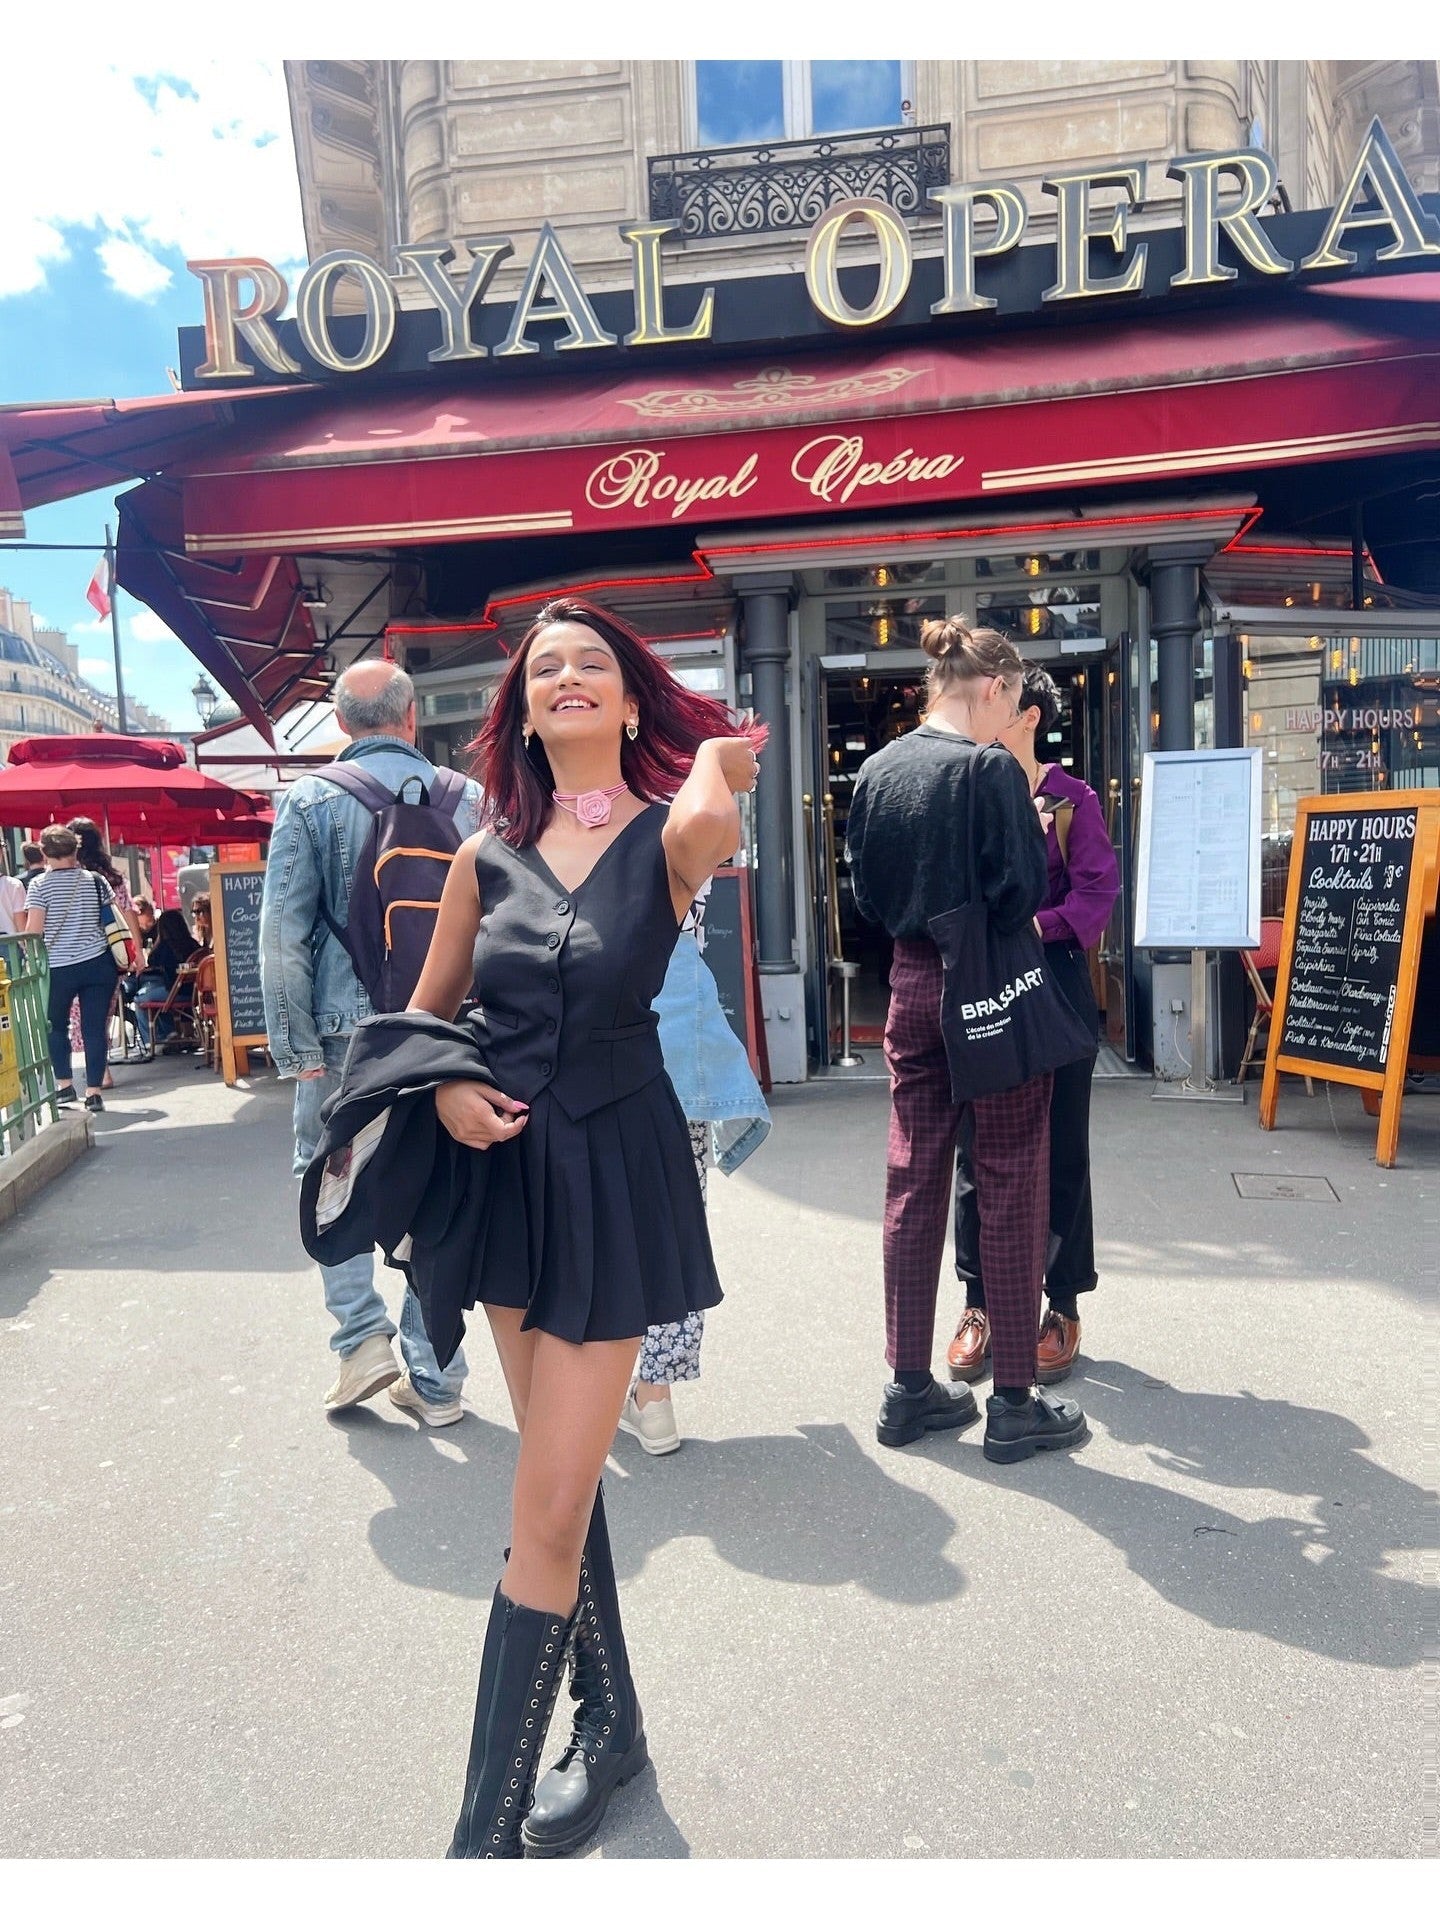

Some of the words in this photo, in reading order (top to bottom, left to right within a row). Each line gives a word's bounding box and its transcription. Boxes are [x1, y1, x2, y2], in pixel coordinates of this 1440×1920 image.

[186, 219, 716, 378] ROYAL
[804, 115, 1440, 327] OPERA
[585, 449, 759, 518] Royal
[790, 434, 964, 504] Opéra
[1286, 709, 1347, 730] HAPPY
[1352, 709, 1414, 729] HOURS
[1356, 750, 1381, 768] 21H
[1309, 819, 1357, 841] HAPPY
[1360, 815, 1416, 840] HOURS
[1330, 844, 1350, 863] 17H
[1359, 843, 1382, 863] 21H
[1308, 866, 1374, 890] Cocktails
[231, 906, 261, 923] Coc
[1373, 912, 1395, 927] Tonic
[1373, 929, 1401, 943] Colada
[1296, 939, 1321, 957] Tequila
[961, 967, 1043, 1020] BRASSART
[1286, 1015, 1316, 1030] Cocktail
[1307, 1035, 1317, 1047] de
